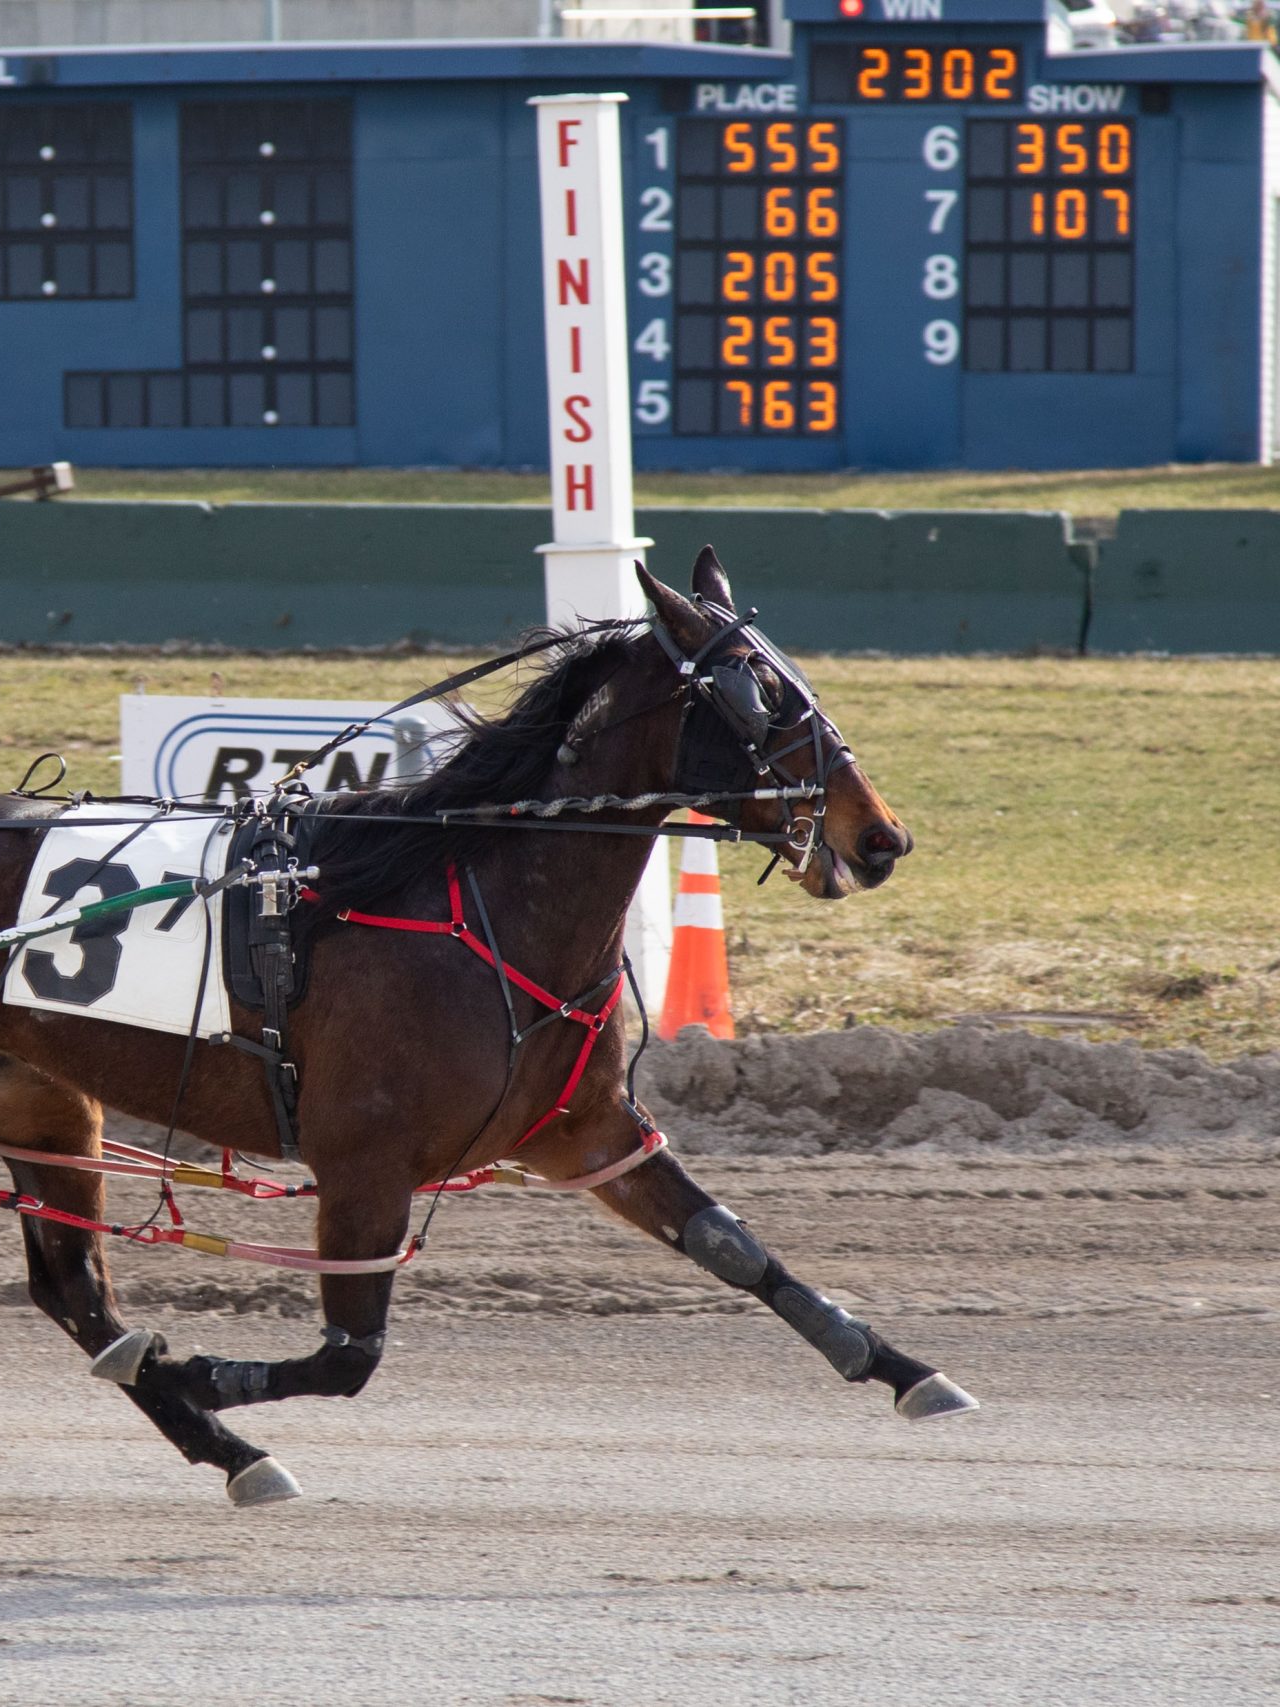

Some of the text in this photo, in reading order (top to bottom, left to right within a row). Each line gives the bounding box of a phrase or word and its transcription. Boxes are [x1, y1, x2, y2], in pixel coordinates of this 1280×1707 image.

[882, 0, 941, 19] WIN
[858, 48, 1017, 99] 2302
[697, 84, 796, 113] PLACE
[1027, 84, 1122, 114] SHOW
[646, 128, 667, 169] 1
[724, 122, 839, 172] 555
[923, 126, 958, 171] 6
[1018, 123, 1130, 174] 350
[640, 187, 672, 231] 2
[765, 187, 838, 237] 66
[925, 190, 957, 233] 7
[1032, 188, 1129, 239] 107
[639, 252, 670, 297] 3
[722, 251, 838, 302] 205
[923, 254, 958, 299] 8
[557, 120, 594, 512] FINISH
[635, 318, 670, 361] 4
[722, 315, 837, 367] 253
[923, 319, 958, 365] 9
[636, 380, 669, 424] 5
[726, 380, 836, 431] 763
[202, 746, 391, 806] RTN
[22, 857, 140, 1006] 3
